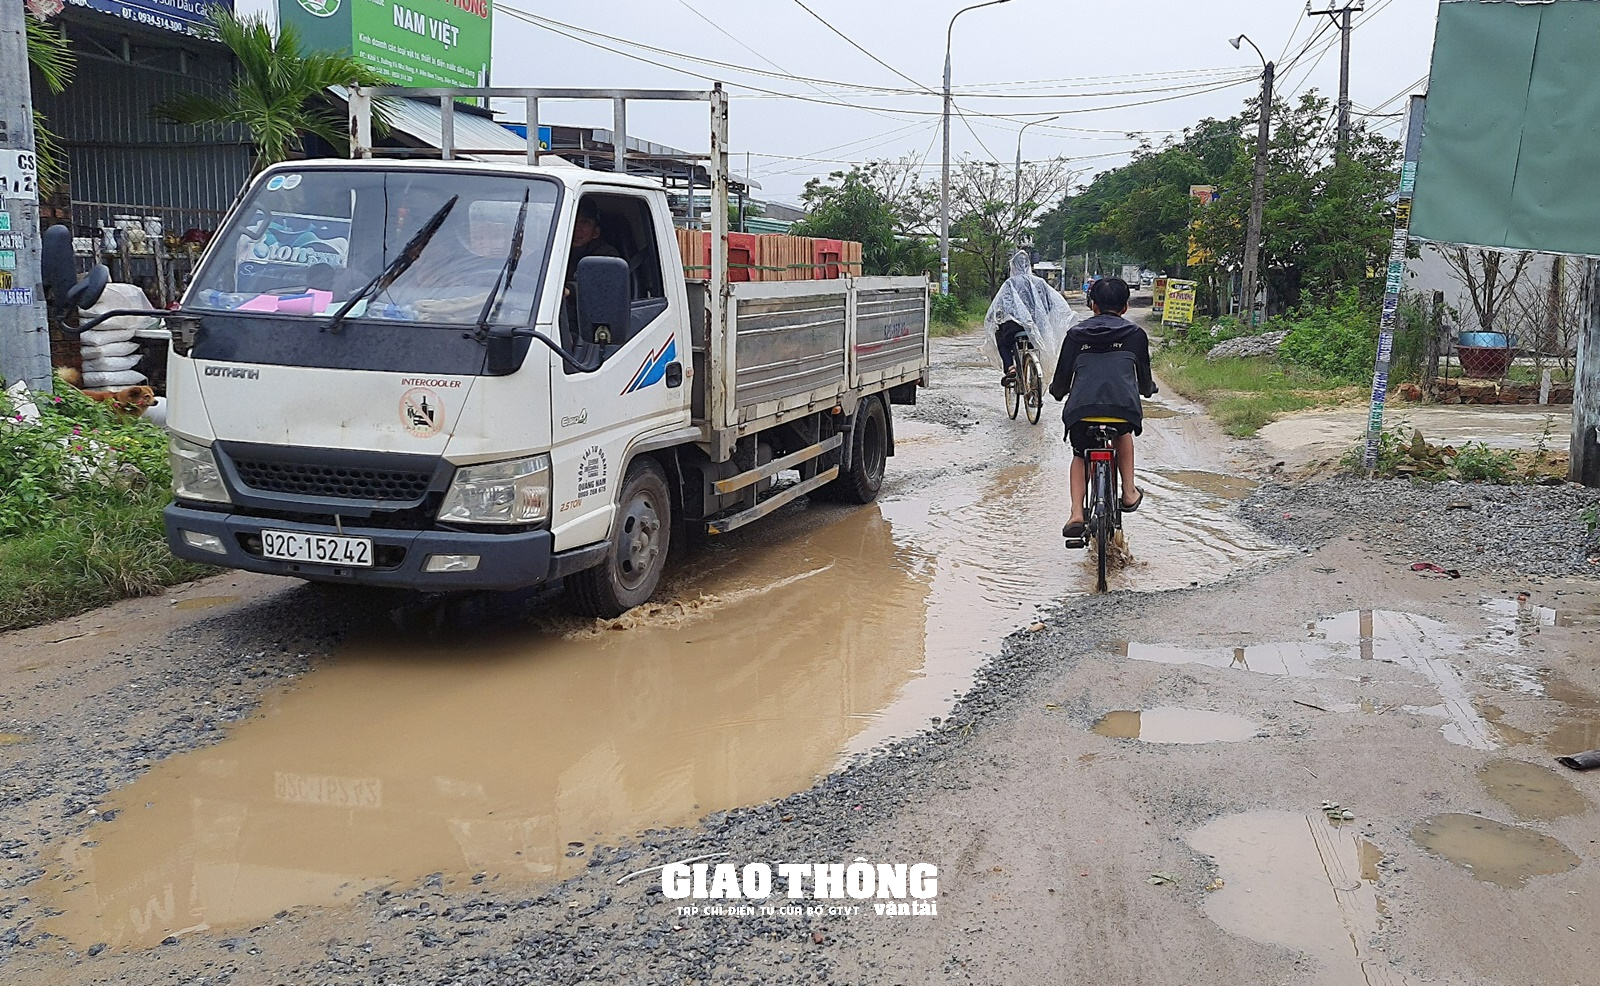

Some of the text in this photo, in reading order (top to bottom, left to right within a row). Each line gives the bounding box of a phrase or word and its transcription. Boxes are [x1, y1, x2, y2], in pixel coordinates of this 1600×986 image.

[393, 3, 459, 50] NAM VIỆT
[18, 154, 35, 170] CS
[204, 365, 260, 380] DOTHANH
[401, 378, 461, 388] INTERCOOLER
[595, 478, 606, 487] NAM
